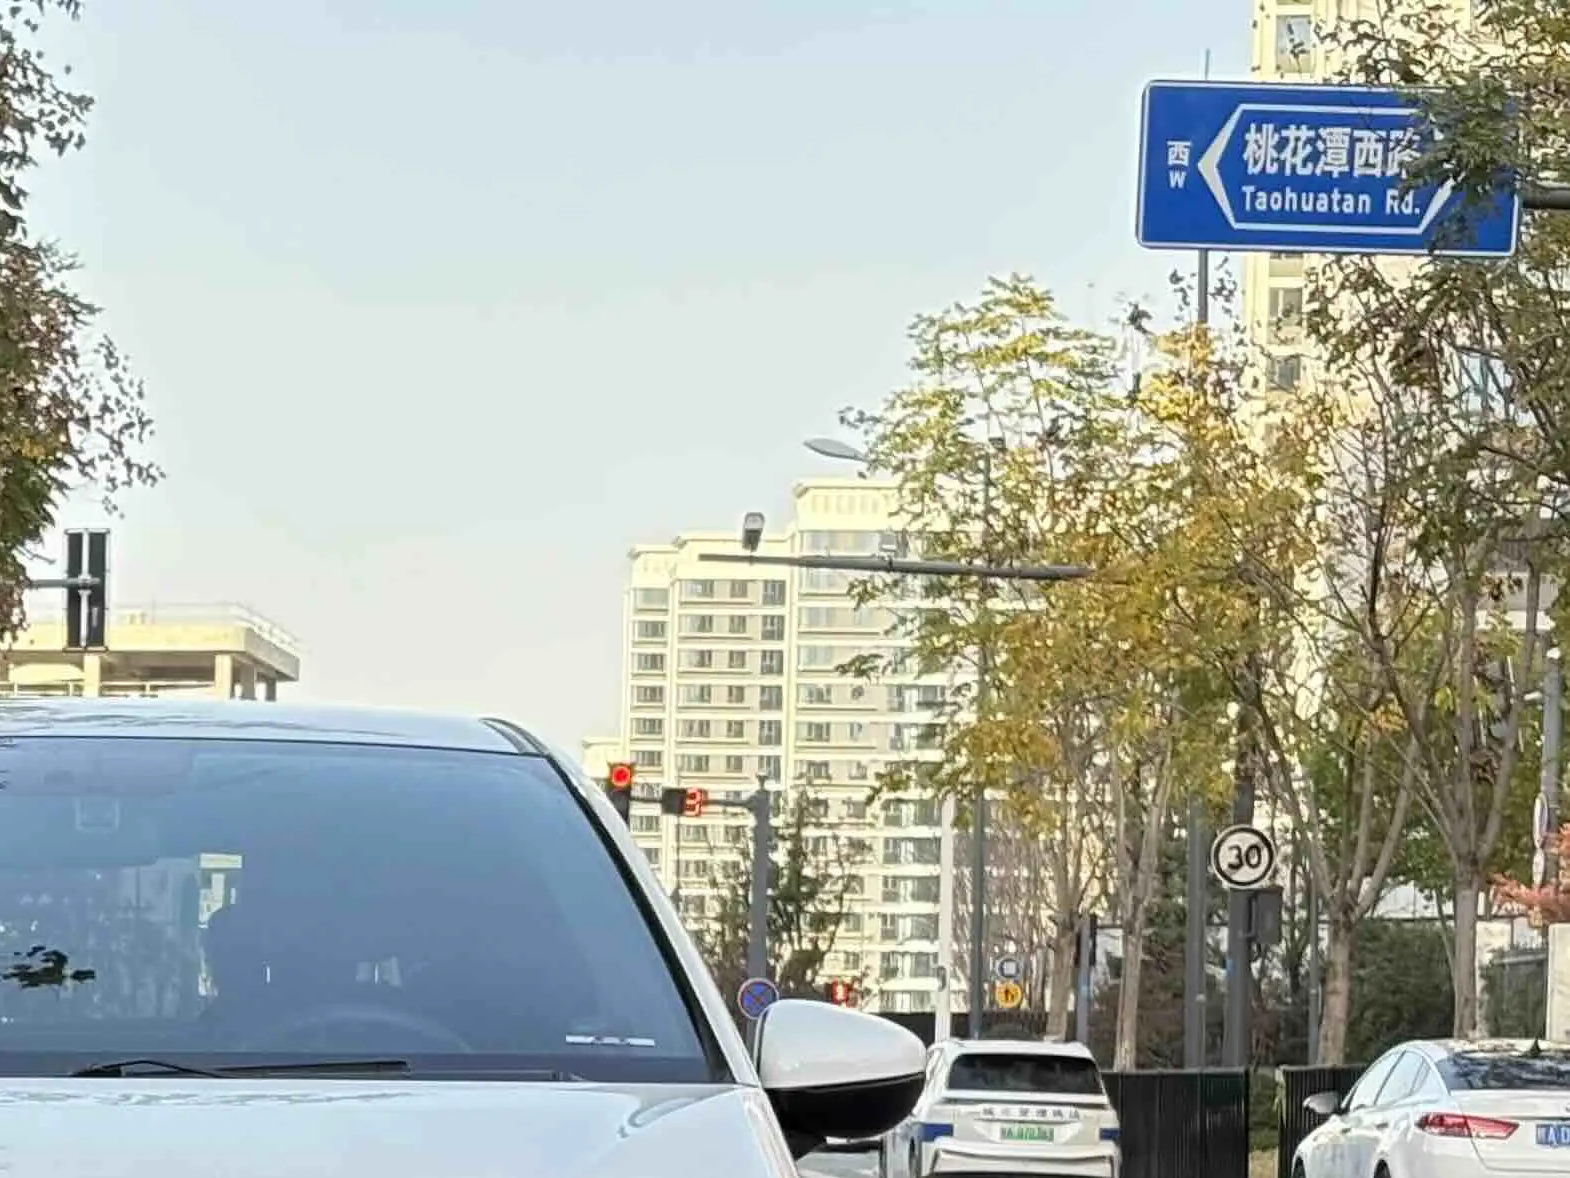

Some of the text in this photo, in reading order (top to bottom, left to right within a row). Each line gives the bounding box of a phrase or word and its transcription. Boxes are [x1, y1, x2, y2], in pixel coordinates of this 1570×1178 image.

[1166, 140, 1191, 167] 西
[1242, 122, 1423, 179] 桃花潭西路
[1168, 170, 1187, 189] W
[1241, 185, 1422, 216] Taohuatan Rd.
[1227, 843, 1262, 871] 30
